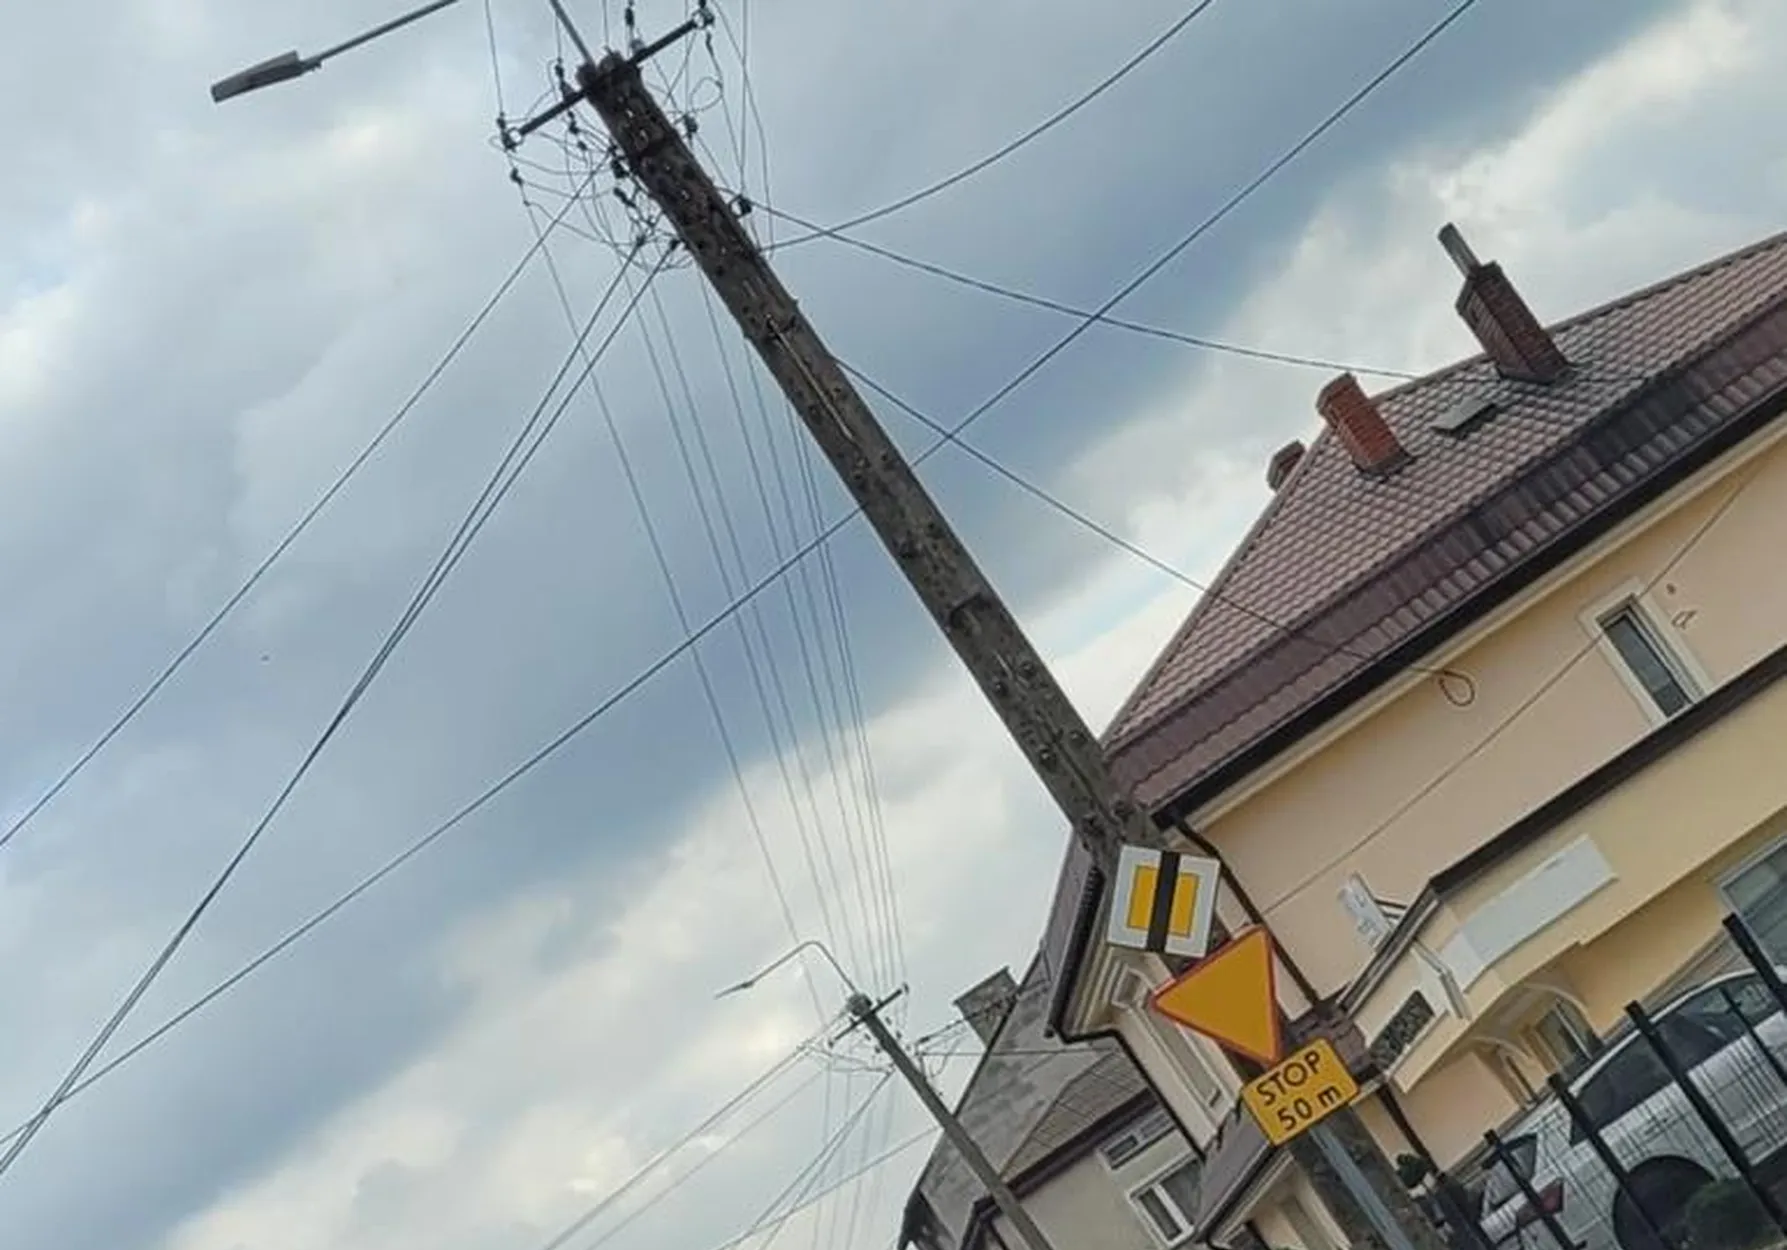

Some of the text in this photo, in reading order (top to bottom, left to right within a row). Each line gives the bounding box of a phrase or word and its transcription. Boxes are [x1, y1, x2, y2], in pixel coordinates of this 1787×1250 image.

[1256, 1050, 1320, 1107] STOP
[1277, 1085, 1342, 1131] 50 m
